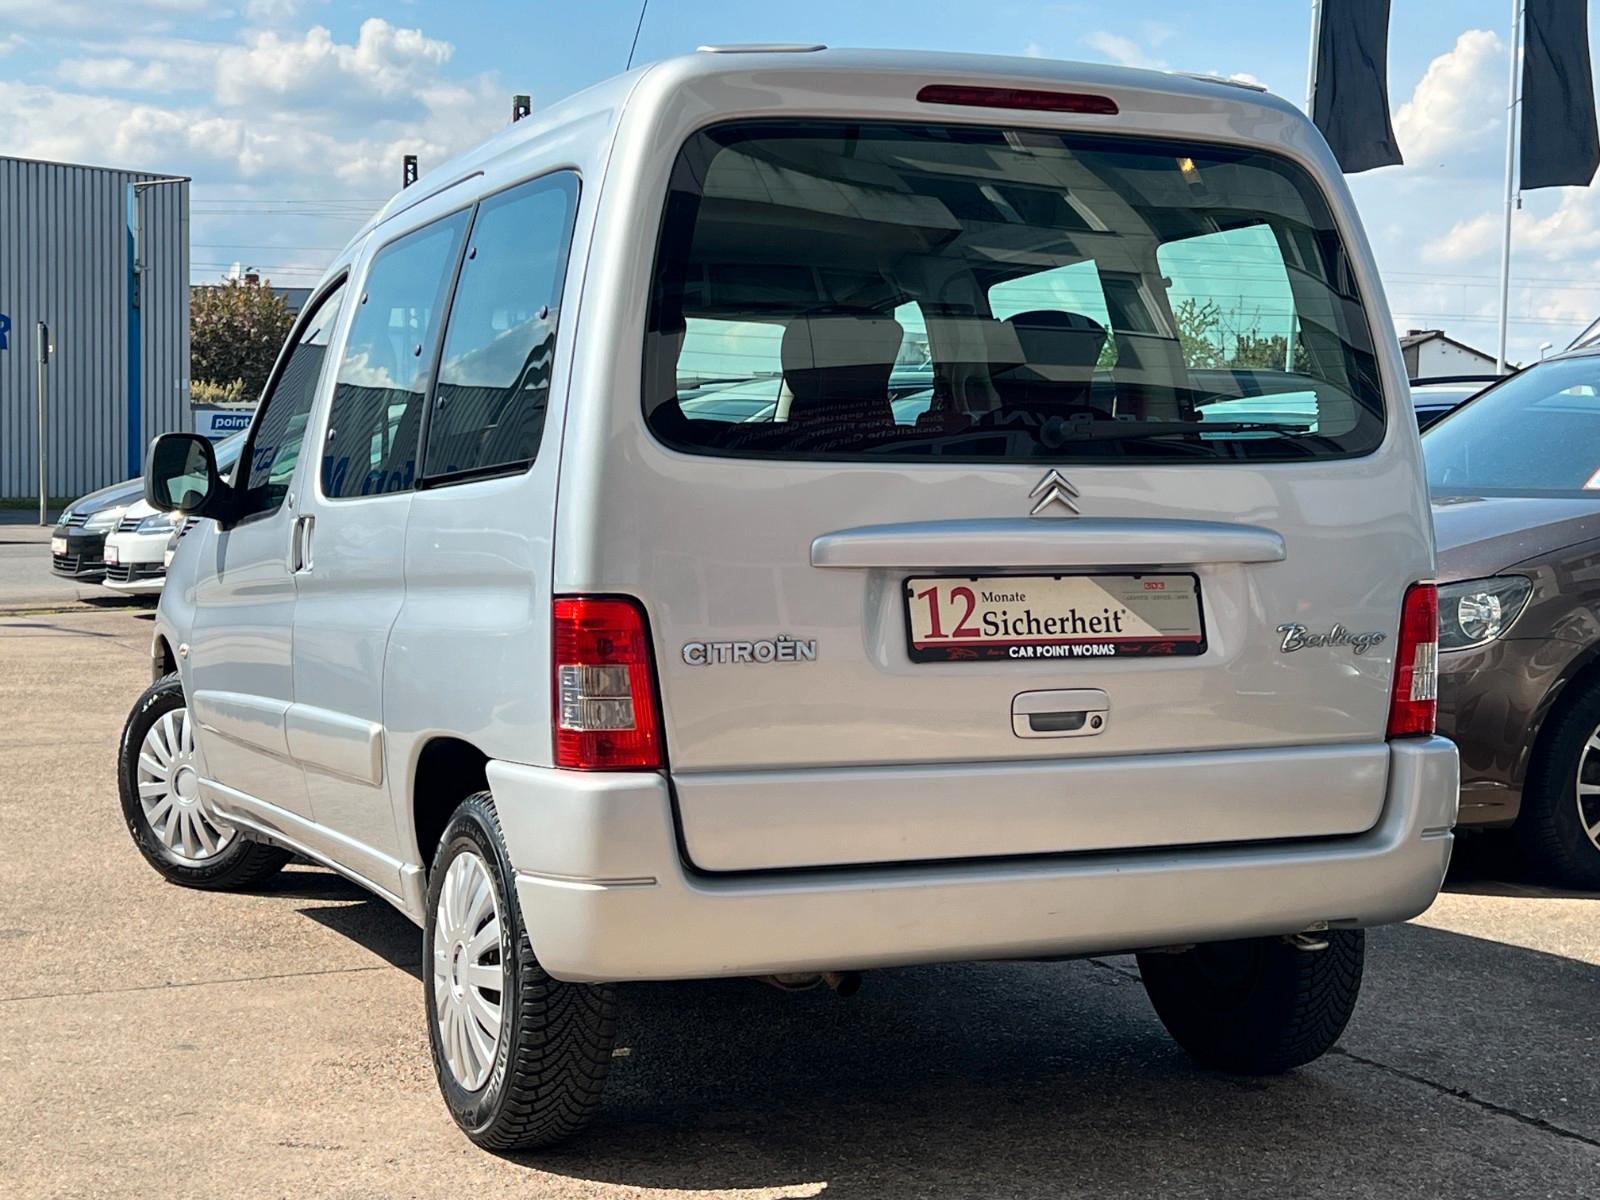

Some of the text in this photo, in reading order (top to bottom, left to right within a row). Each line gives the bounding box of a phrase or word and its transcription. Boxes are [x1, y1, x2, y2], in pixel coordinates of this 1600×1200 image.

[214, 417, 250, 428] point
[981, 591, 1026, 602] Monate
[917, 586, 981, 638] 12
[682, 634, 817, 666] CITROËN
[1276, 623, 1387, 655] Berlingo
[1008, 646, 1034, 658] CAR
[1036, 645, 1070, 657] POINT
[1071, 644, 1115, 656] WORMS
